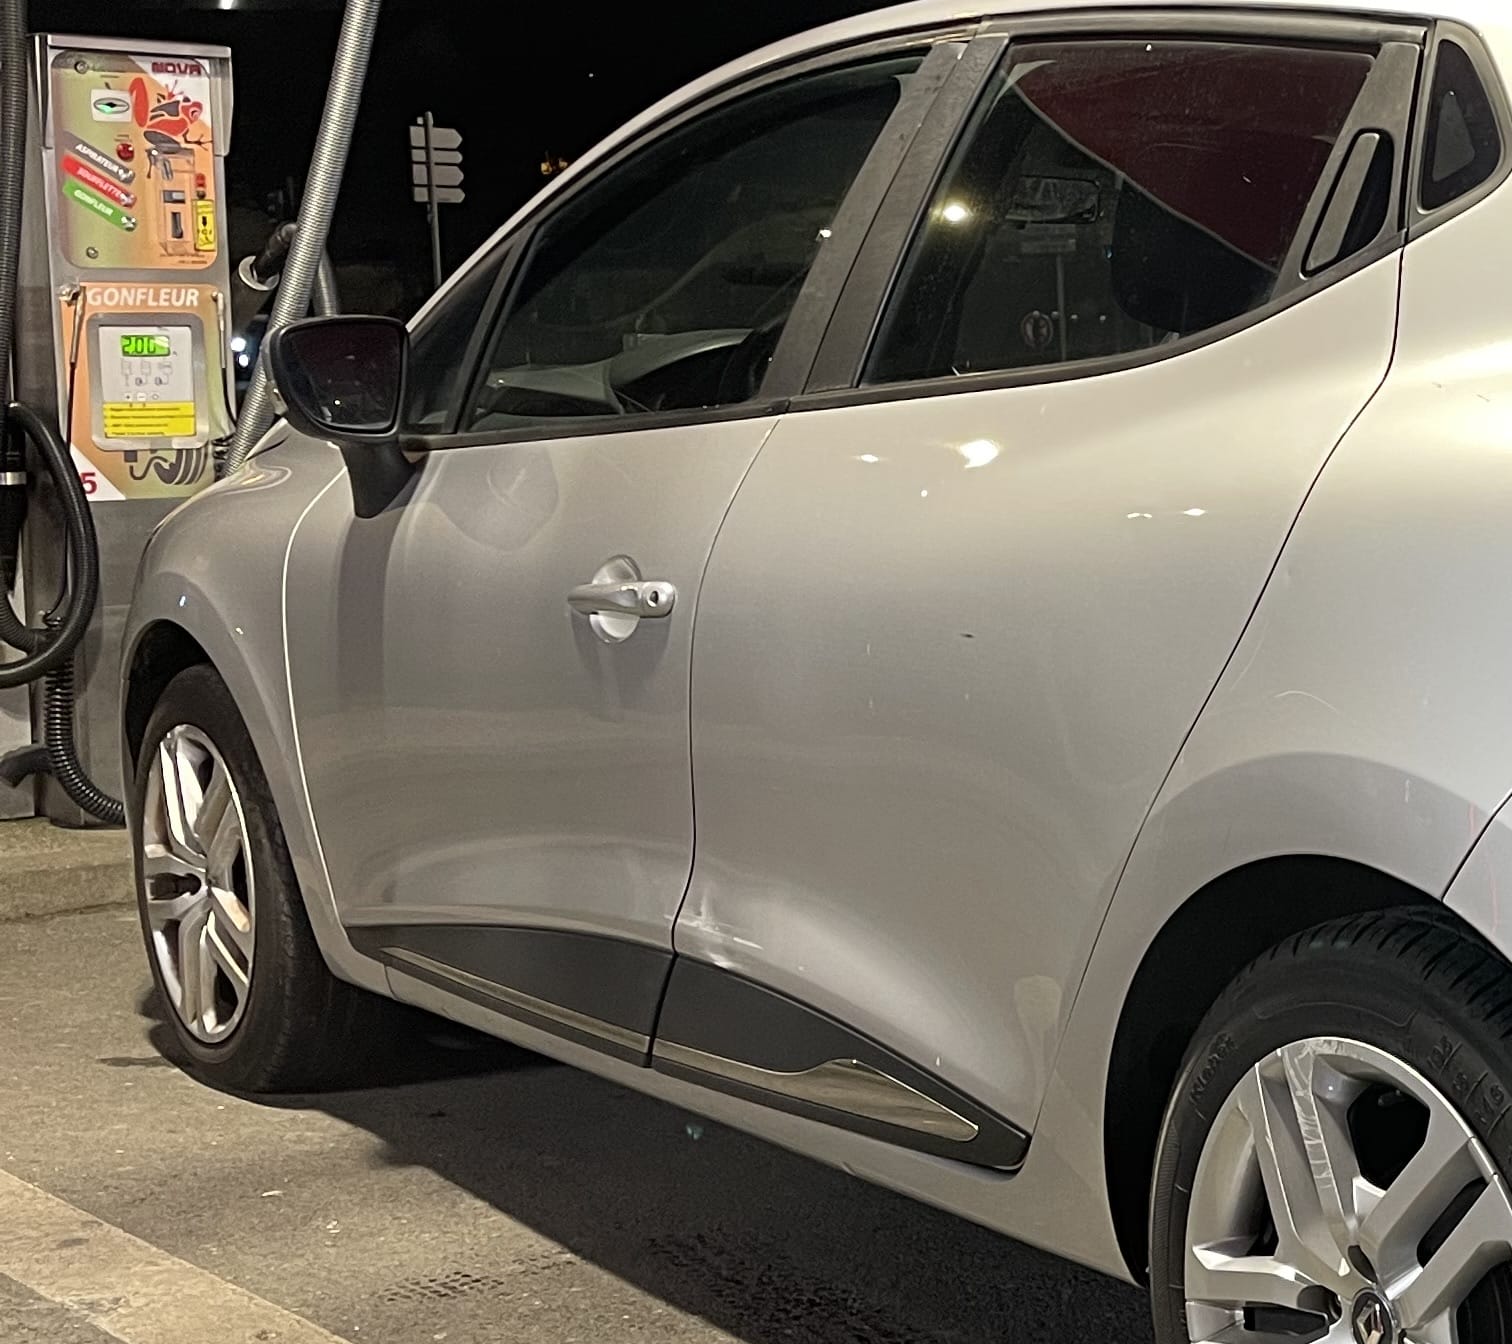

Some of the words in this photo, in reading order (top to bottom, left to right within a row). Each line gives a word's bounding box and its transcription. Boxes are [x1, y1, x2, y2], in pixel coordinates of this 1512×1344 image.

[75, 143, 119, 172] ASPIRATEUR
[74, 189, 114, 216] GONFLEUR
[87, 288, 200, 306] GONFLEUR
